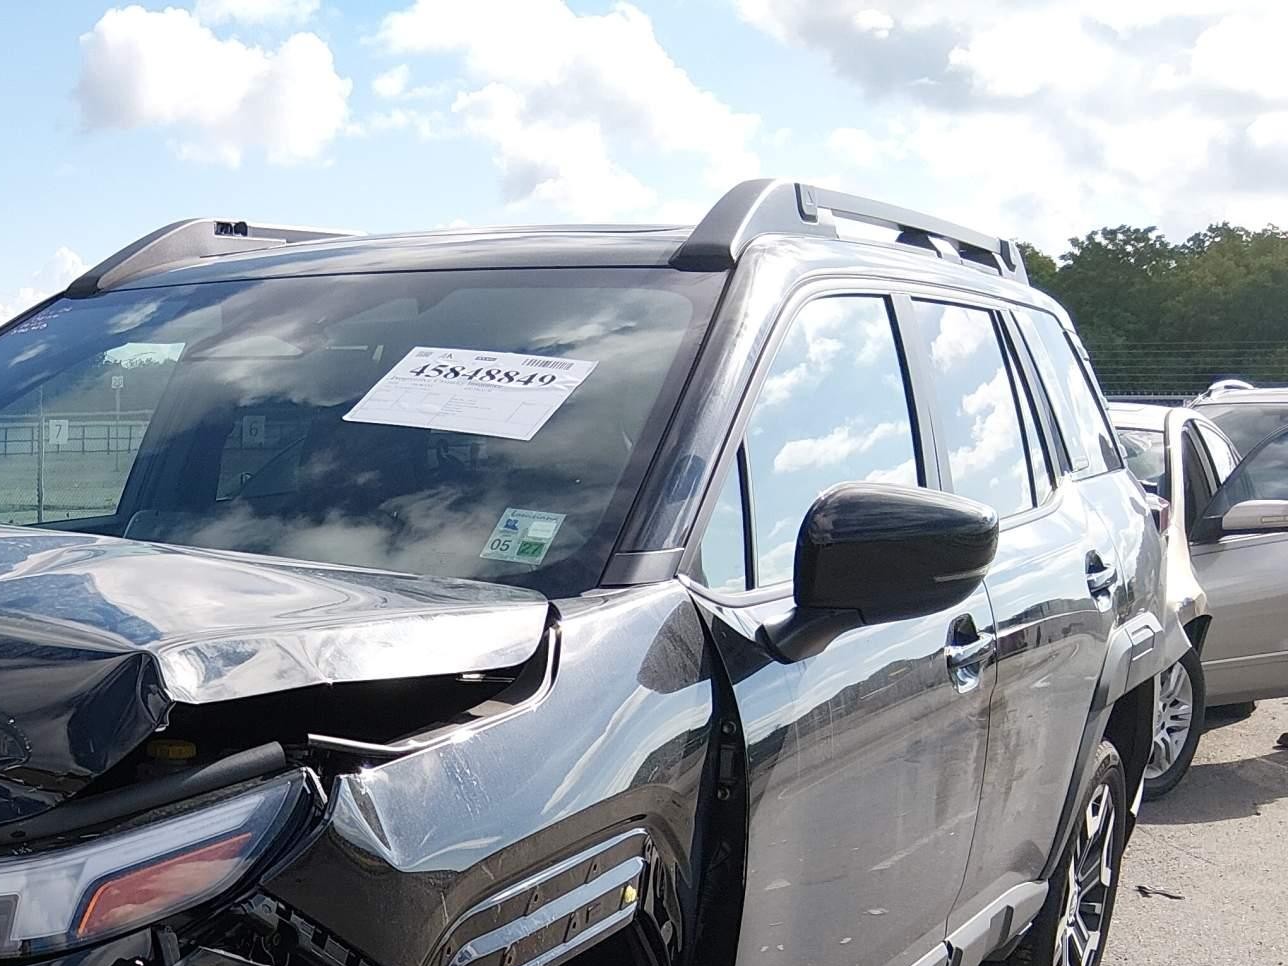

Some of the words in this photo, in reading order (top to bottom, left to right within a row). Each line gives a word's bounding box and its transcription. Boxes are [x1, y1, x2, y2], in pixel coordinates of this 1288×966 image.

[409, 363, 557, 387] 45848849
[55, 424, 62, 439] 7
[249, 421, 258, 437] 6
[490, 538, 513, 552] 05
[520, 541, 546, 555] 27
